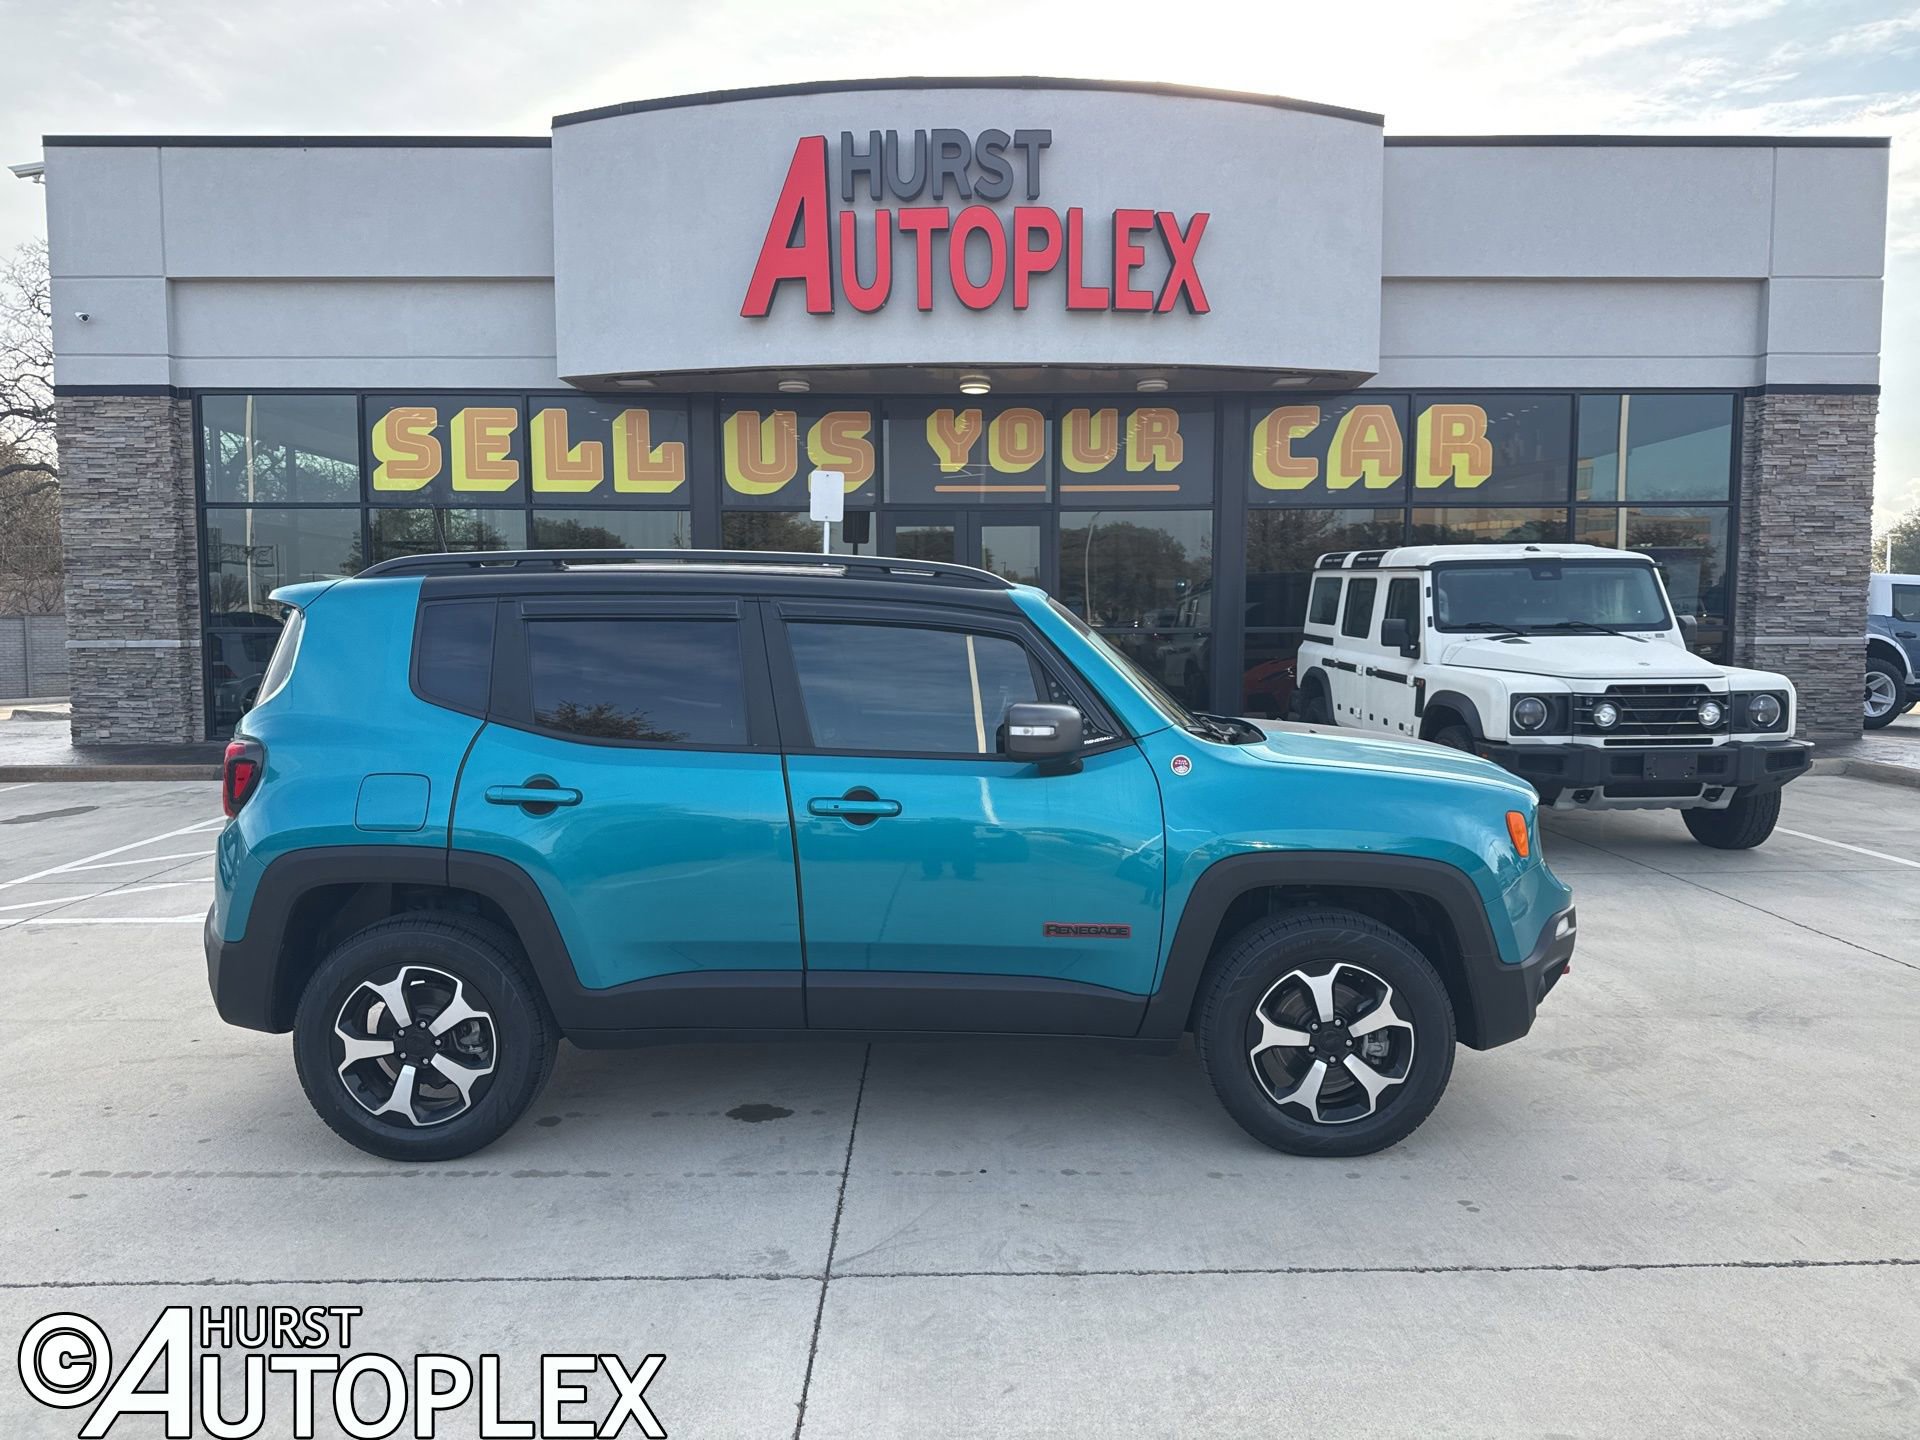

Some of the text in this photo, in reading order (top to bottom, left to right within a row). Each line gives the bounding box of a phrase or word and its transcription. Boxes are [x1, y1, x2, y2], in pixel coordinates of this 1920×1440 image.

[840, 128, 1052, 201] HURST
[740, 135, 1211, 317] AUTOPLEX
[371, 403, 1493, 495] SELL US YOUR CAR
[1046, 923, 1129, 937] RENEGADE
